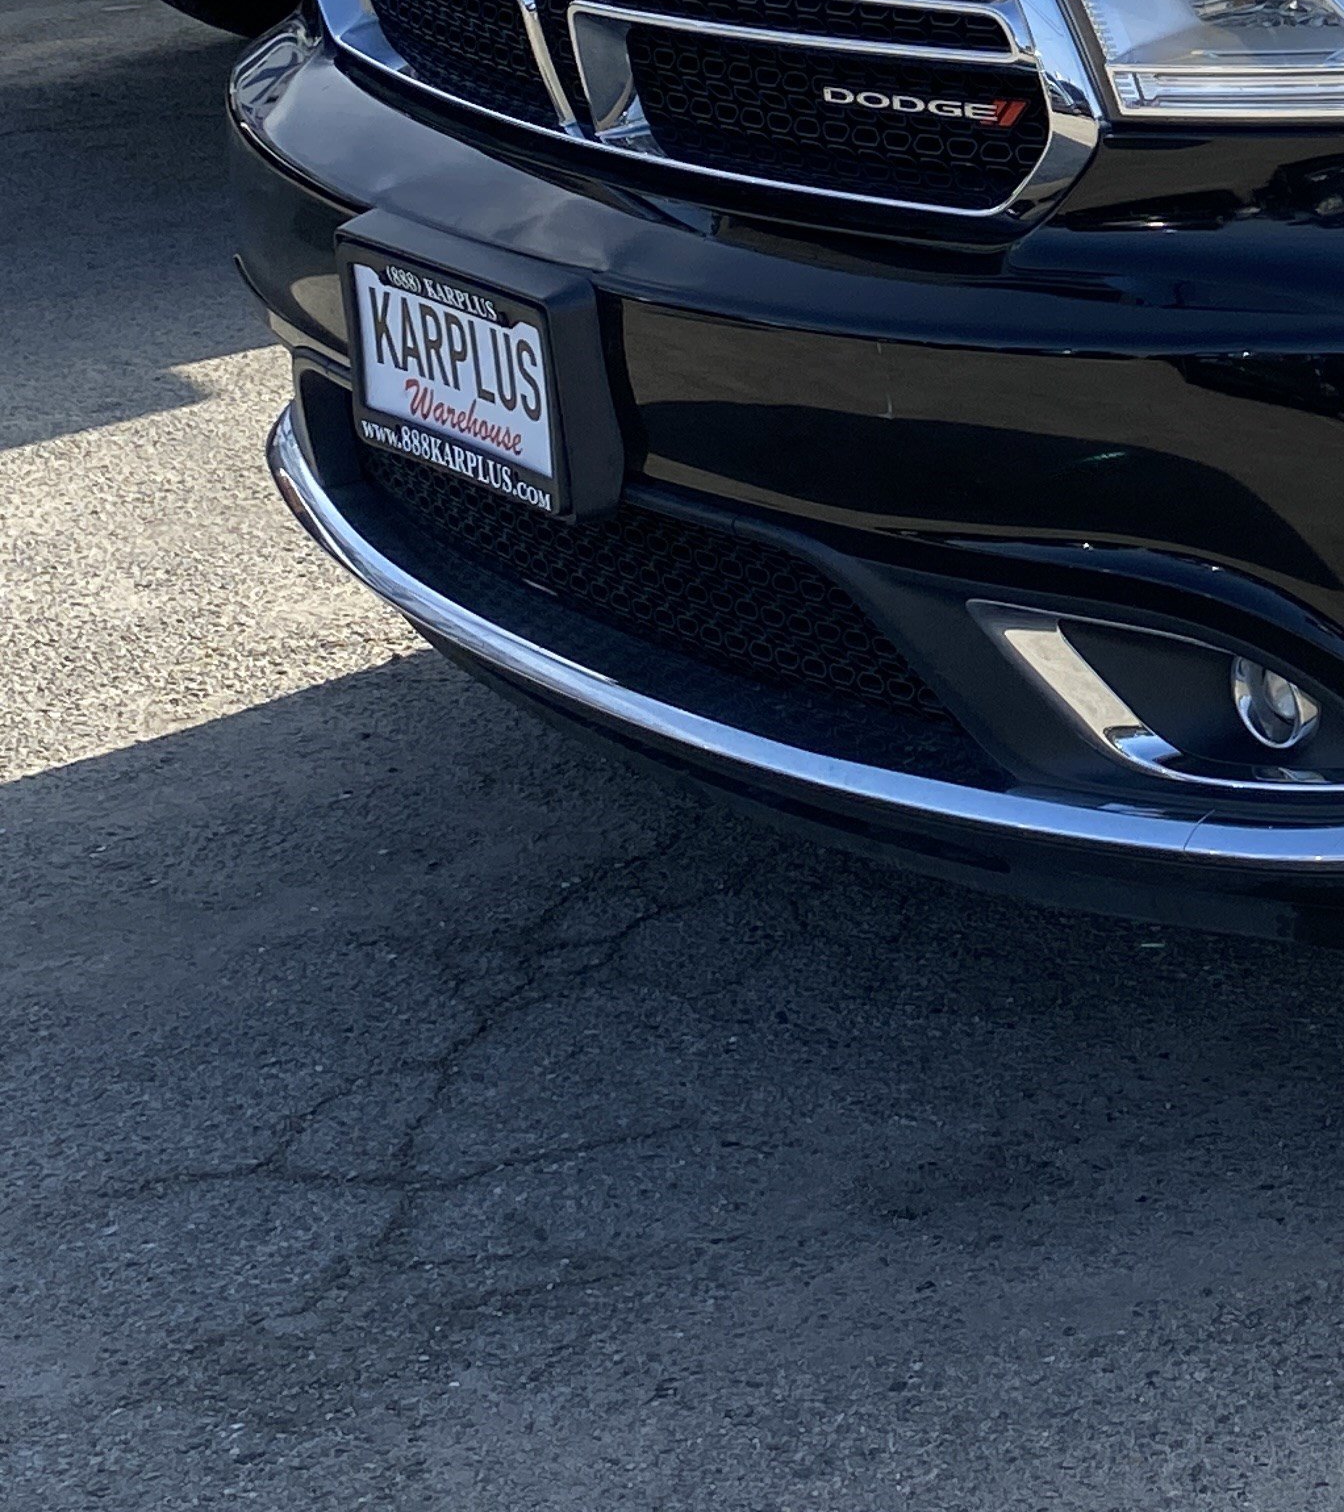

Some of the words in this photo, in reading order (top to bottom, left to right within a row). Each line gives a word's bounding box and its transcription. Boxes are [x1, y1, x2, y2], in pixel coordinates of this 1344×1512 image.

[822, 86, 998, 122] DODGE
[386, 264, 422, 293] (888)
[423, 278, 498, 322] KARPLUS
[368, 285, 542, 422] KARPLUS
[405, 377, 524, 456] Warehouse
